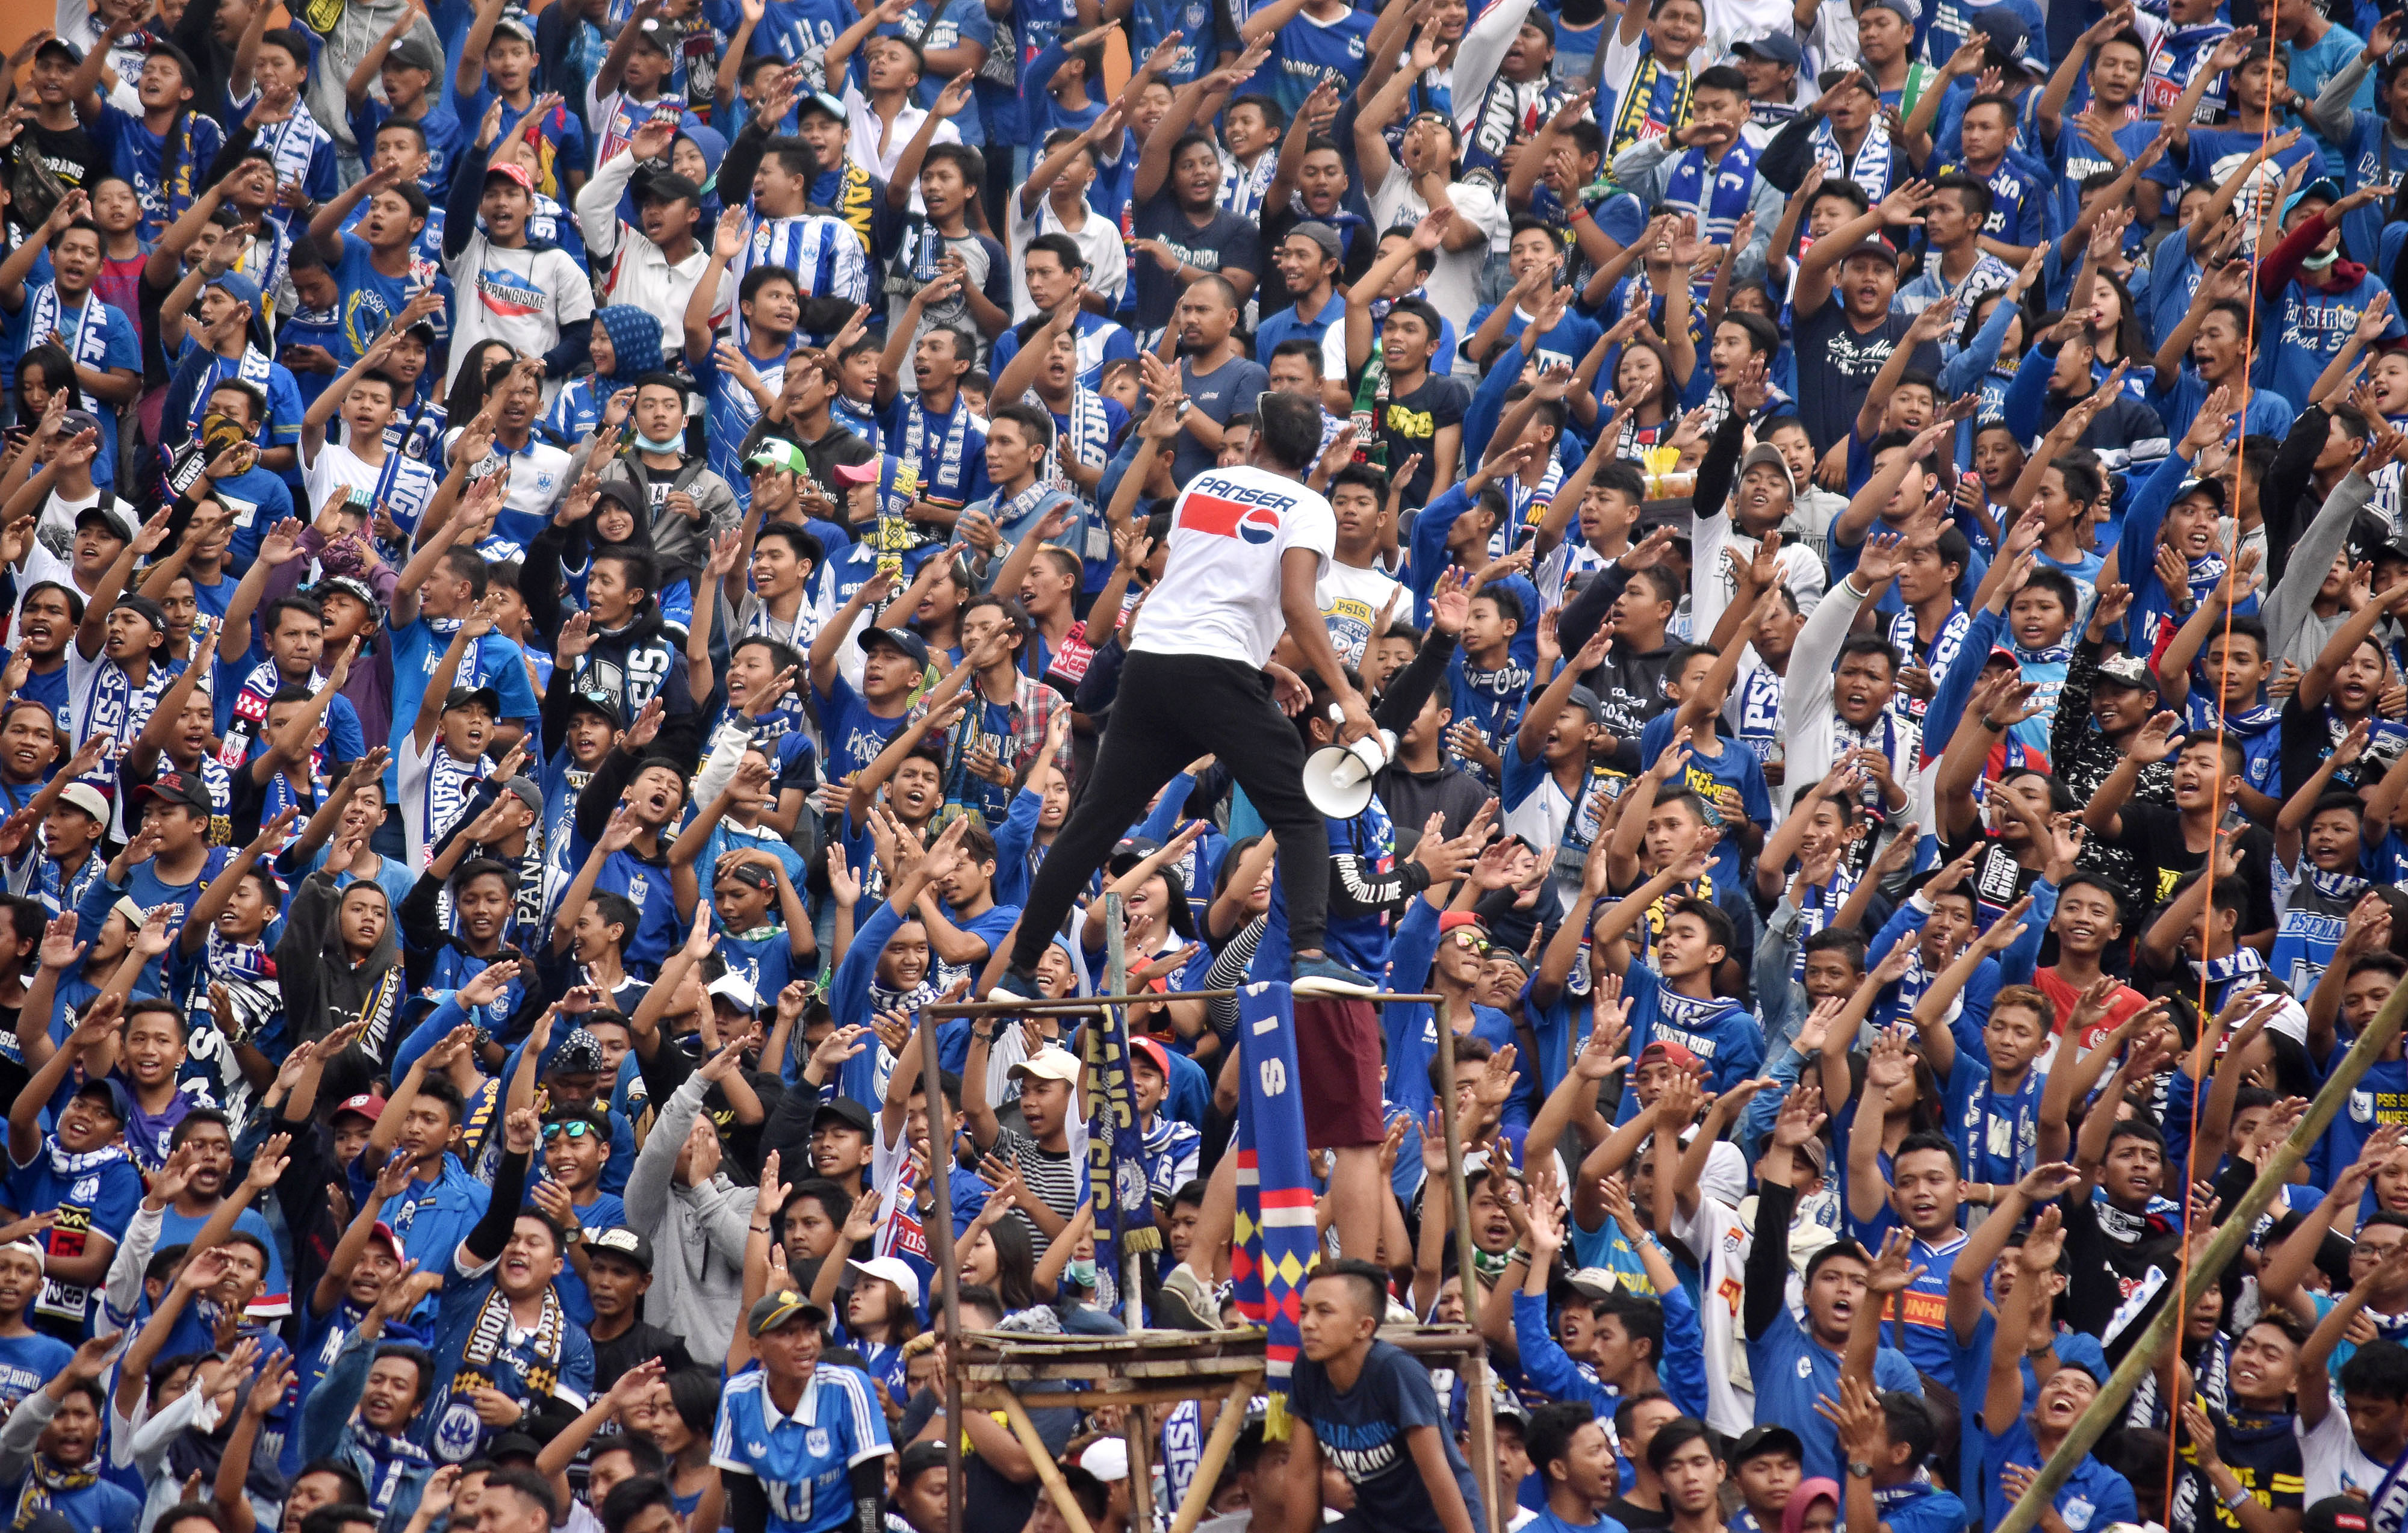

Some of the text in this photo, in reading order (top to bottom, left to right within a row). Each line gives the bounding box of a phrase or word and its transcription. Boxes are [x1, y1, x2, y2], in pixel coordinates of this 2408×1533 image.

[1194, 476, 1298, 513] PANSER
[1338, 601, 1367, 618] PSIS
[1348, 620, 1367, 631] THE
[1985, 849, 2006, 892] PANSER
[1997, 858, 2019, 898] BIRU
[2376, 1092, 2397, 1107] PSIS
[1918, 1275, 1943, 1285] adidas
